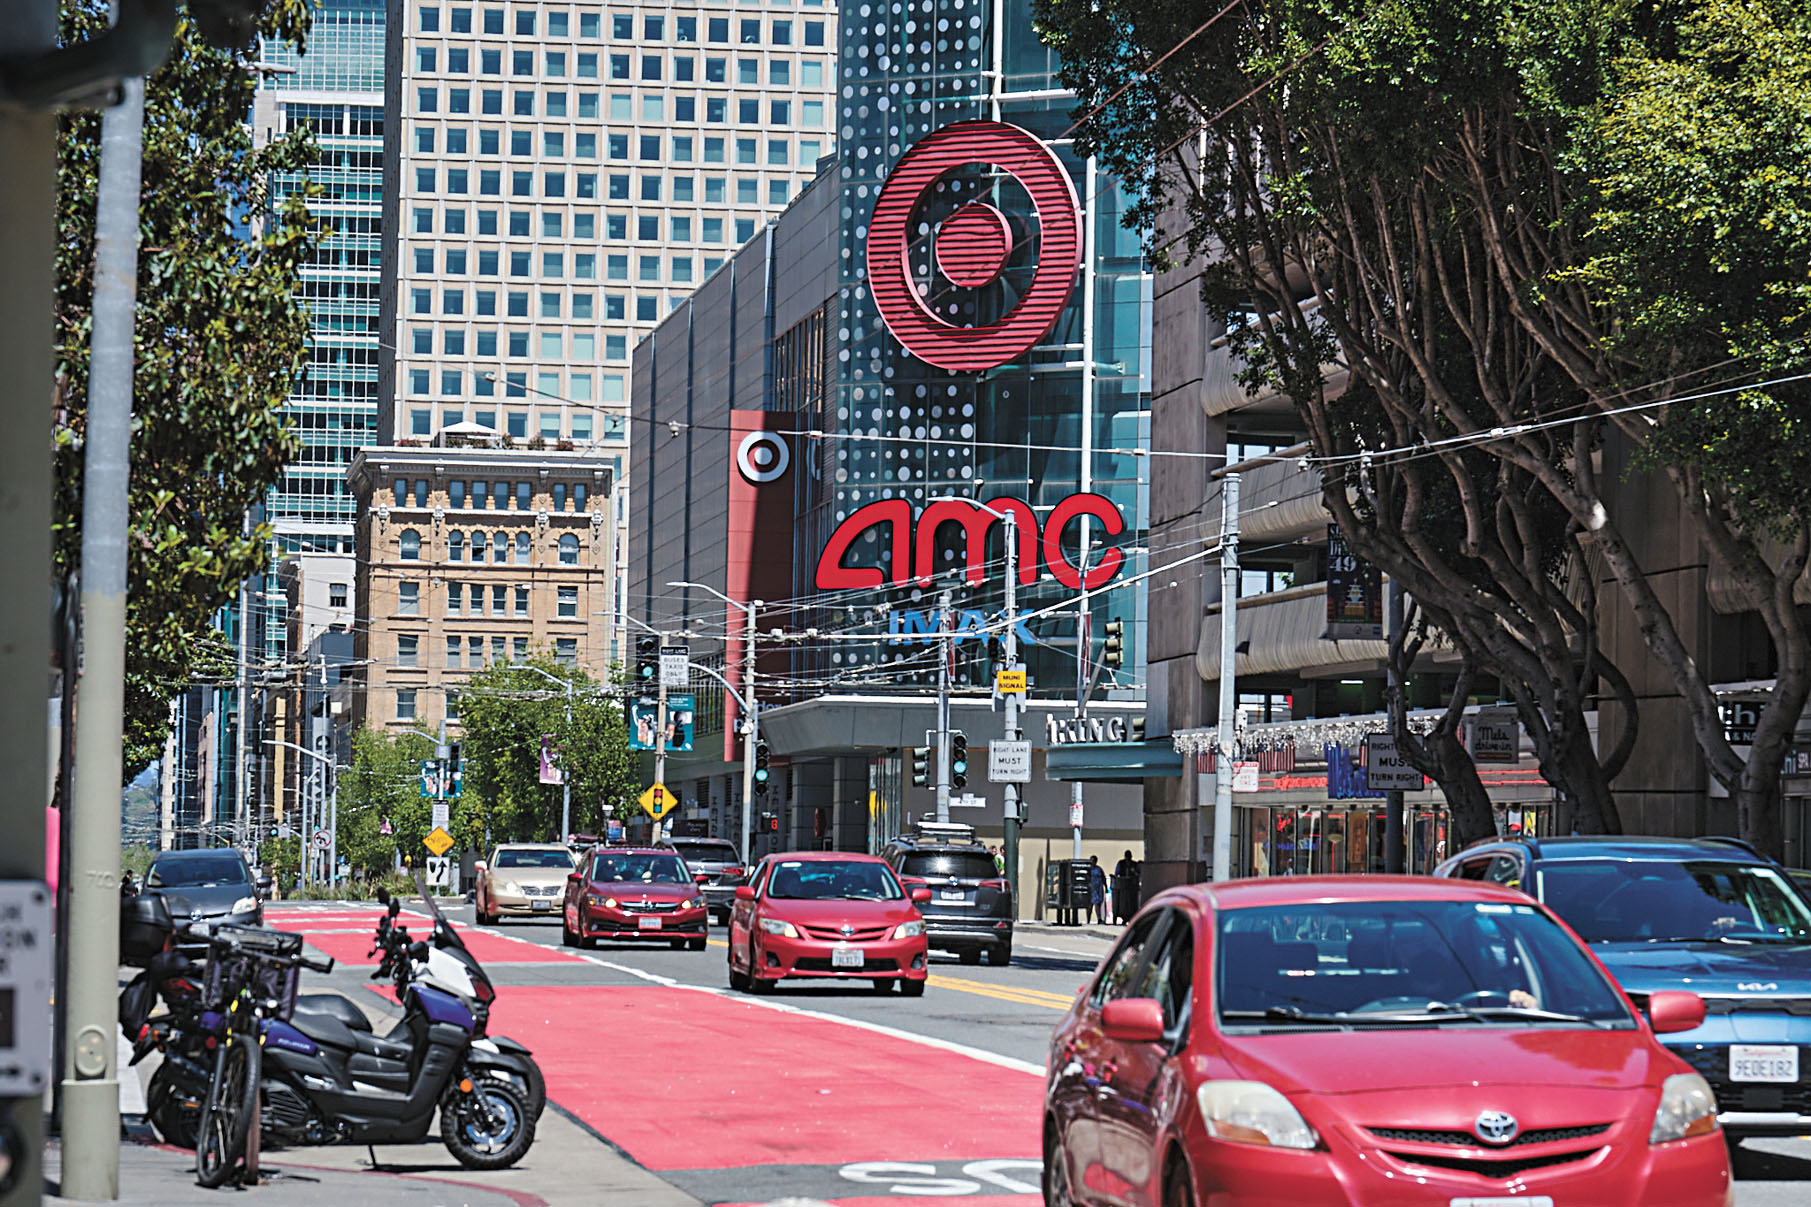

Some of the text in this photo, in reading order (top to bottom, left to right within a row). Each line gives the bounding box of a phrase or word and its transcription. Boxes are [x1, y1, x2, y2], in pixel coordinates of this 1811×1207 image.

[998, 757, 1021, 765] MUST
[1379, 758, 1409, 767] MUS
[1371, 773, 1420, 782] TURN RIGHT
